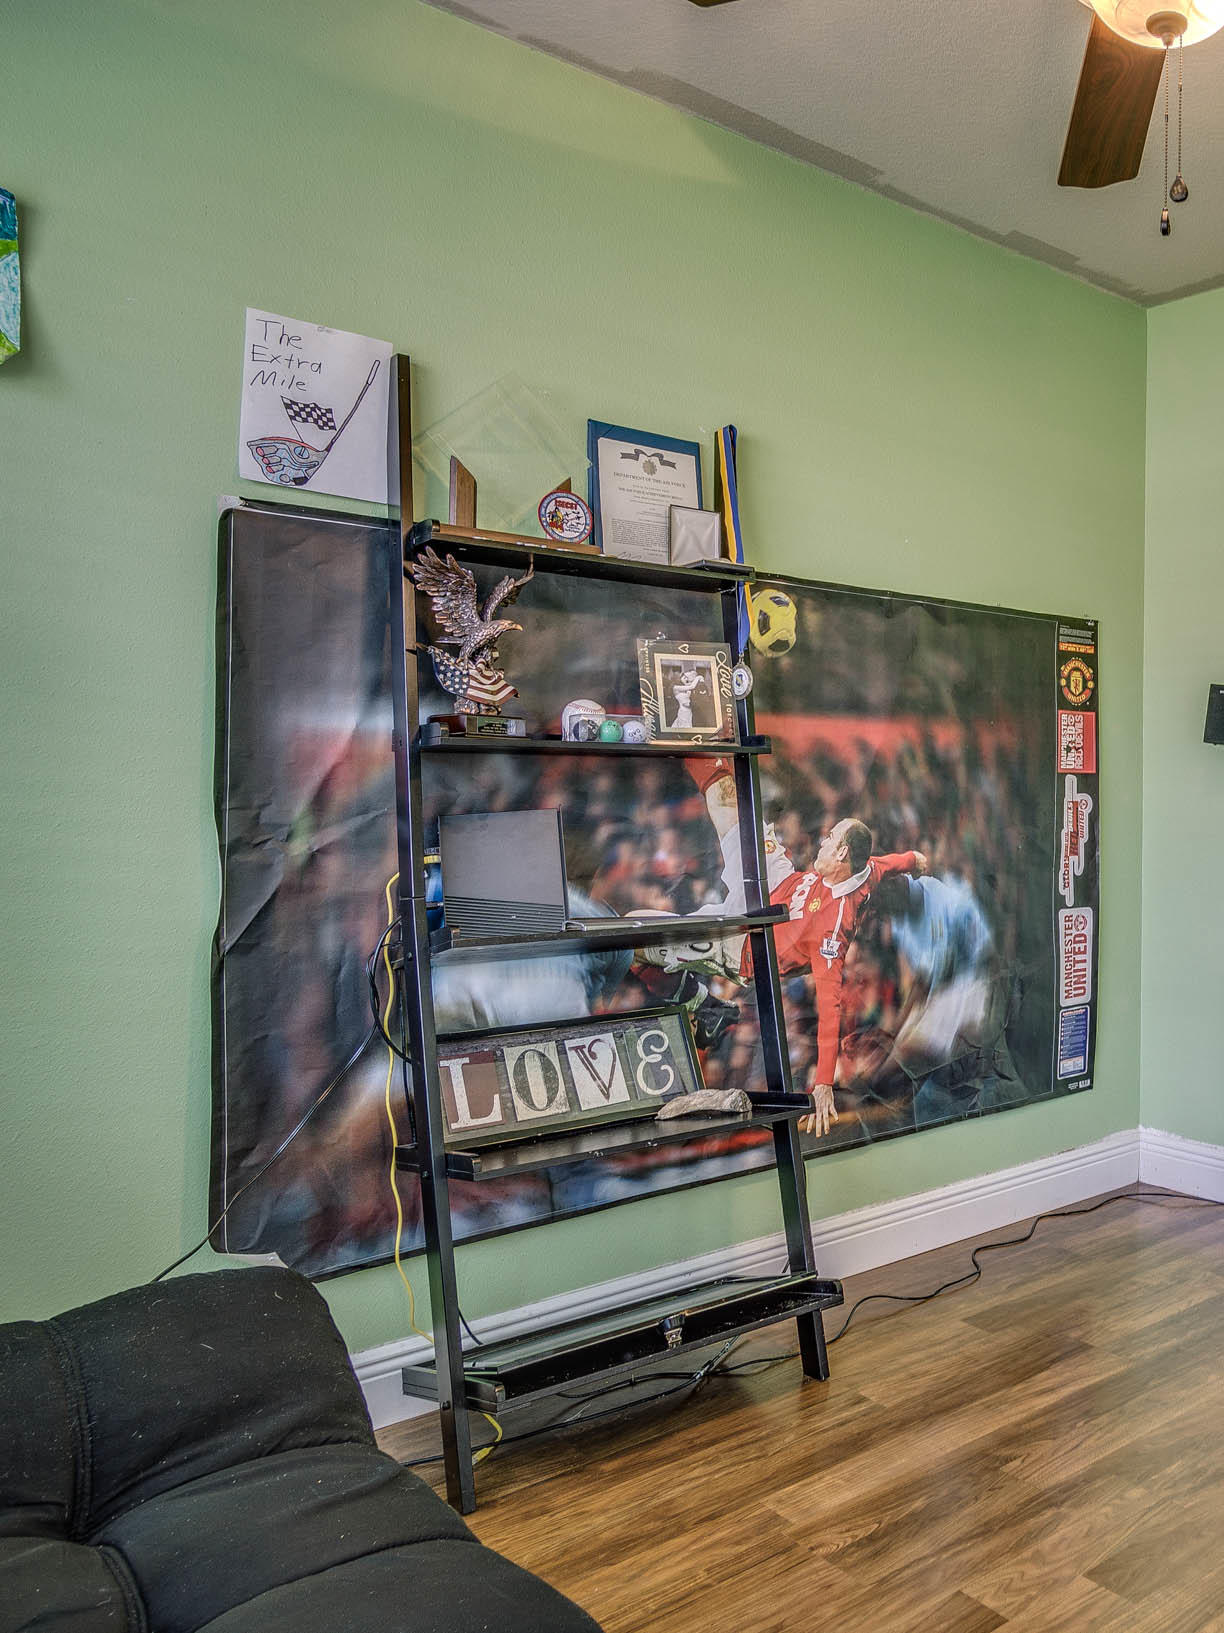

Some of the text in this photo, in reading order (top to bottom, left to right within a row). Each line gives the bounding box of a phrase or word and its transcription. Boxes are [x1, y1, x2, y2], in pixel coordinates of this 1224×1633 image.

[255, 318, 303, 350] The
[250, 369, 307, 392] Mile
[251, 343, 323, 375] Extra
[613, 471, 645, 481] DEPARTMENT
[715, 651, 734, 699] Love
[1060, 713, 1068, 769] MANCHESTER
[1066, 726, 1076, 769] UNED
[1074, 714, 1084, 770] RED DEVILS
[1064, 914, 1074, 1000] MANCHESTER
[1073, 932, 1088, 998] UNITED
[439, 1029, 675, 1130] LOVE
